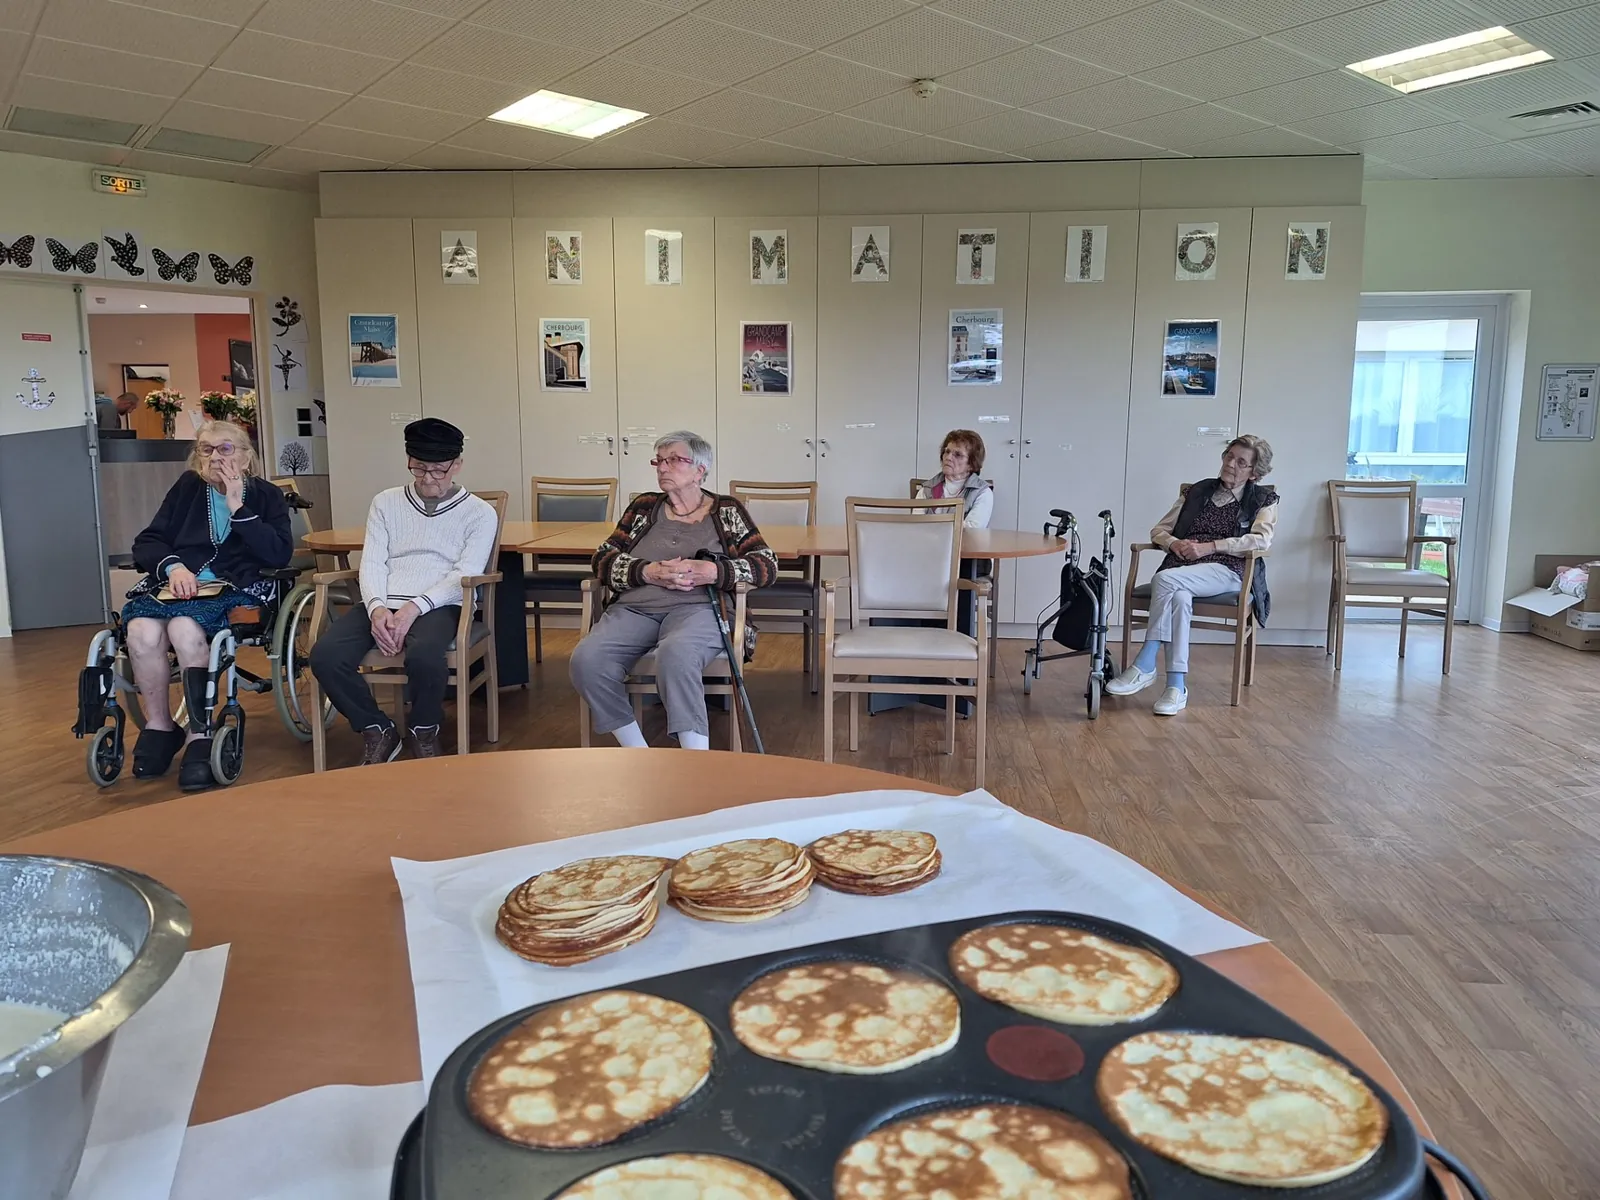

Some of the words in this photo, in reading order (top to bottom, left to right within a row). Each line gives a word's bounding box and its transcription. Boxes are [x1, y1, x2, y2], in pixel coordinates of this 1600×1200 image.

[102, 176, 140, 189] SORTIE
[955, 315, 995, 324] Cherbourg
[546, 324, 583, 332] CHERBOURG
[747, 325, 785, 337] GRANDCAMP
[1173, 327, 1213, 336] GRANDCAMP
